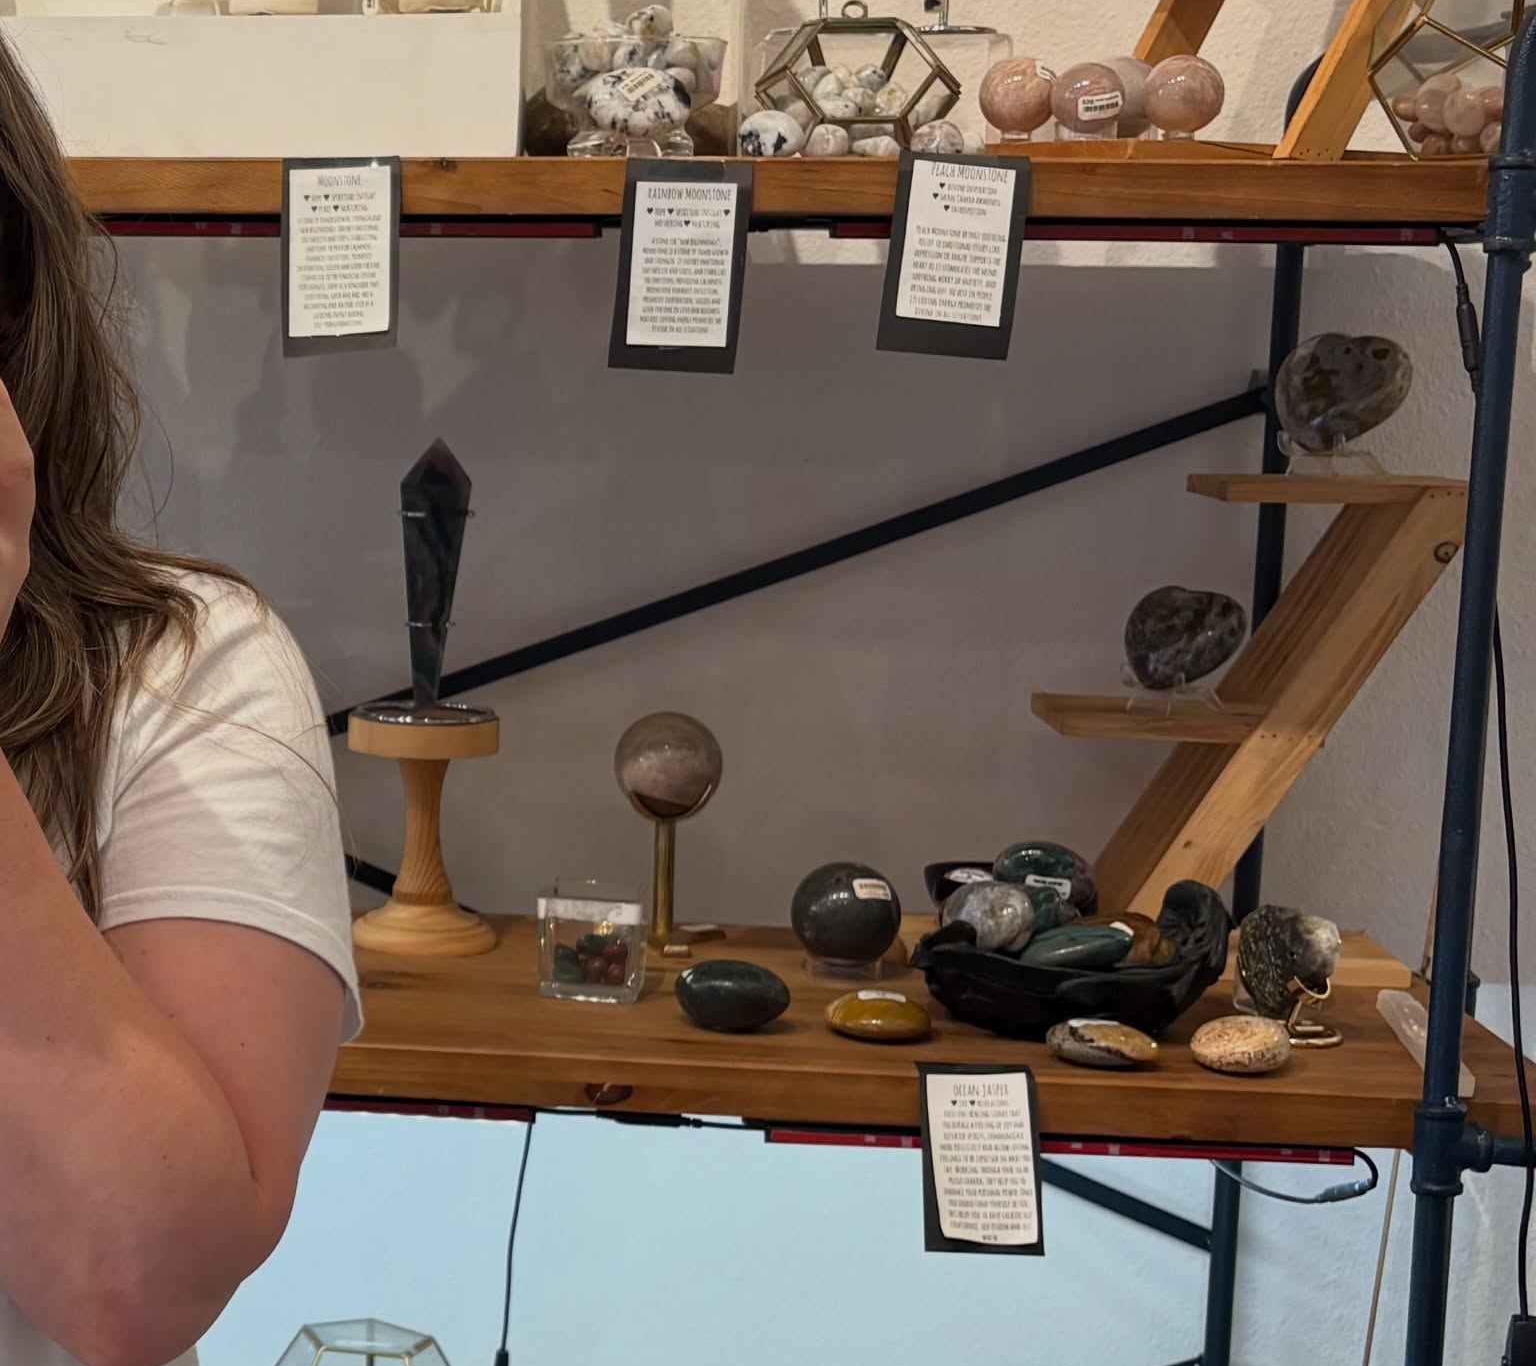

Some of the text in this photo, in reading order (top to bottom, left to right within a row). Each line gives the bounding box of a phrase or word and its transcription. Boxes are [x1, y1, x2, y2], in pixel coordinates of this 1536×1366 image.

[932, 163, 1008, 183] PEACH MOONSTONE
[318, 174, 361, 187] MOONSTONE
[648, 188, 731, 201] RAINBOW MOONSTONE
[953, 1083, 1009, 1098] OCEAN JASPER
